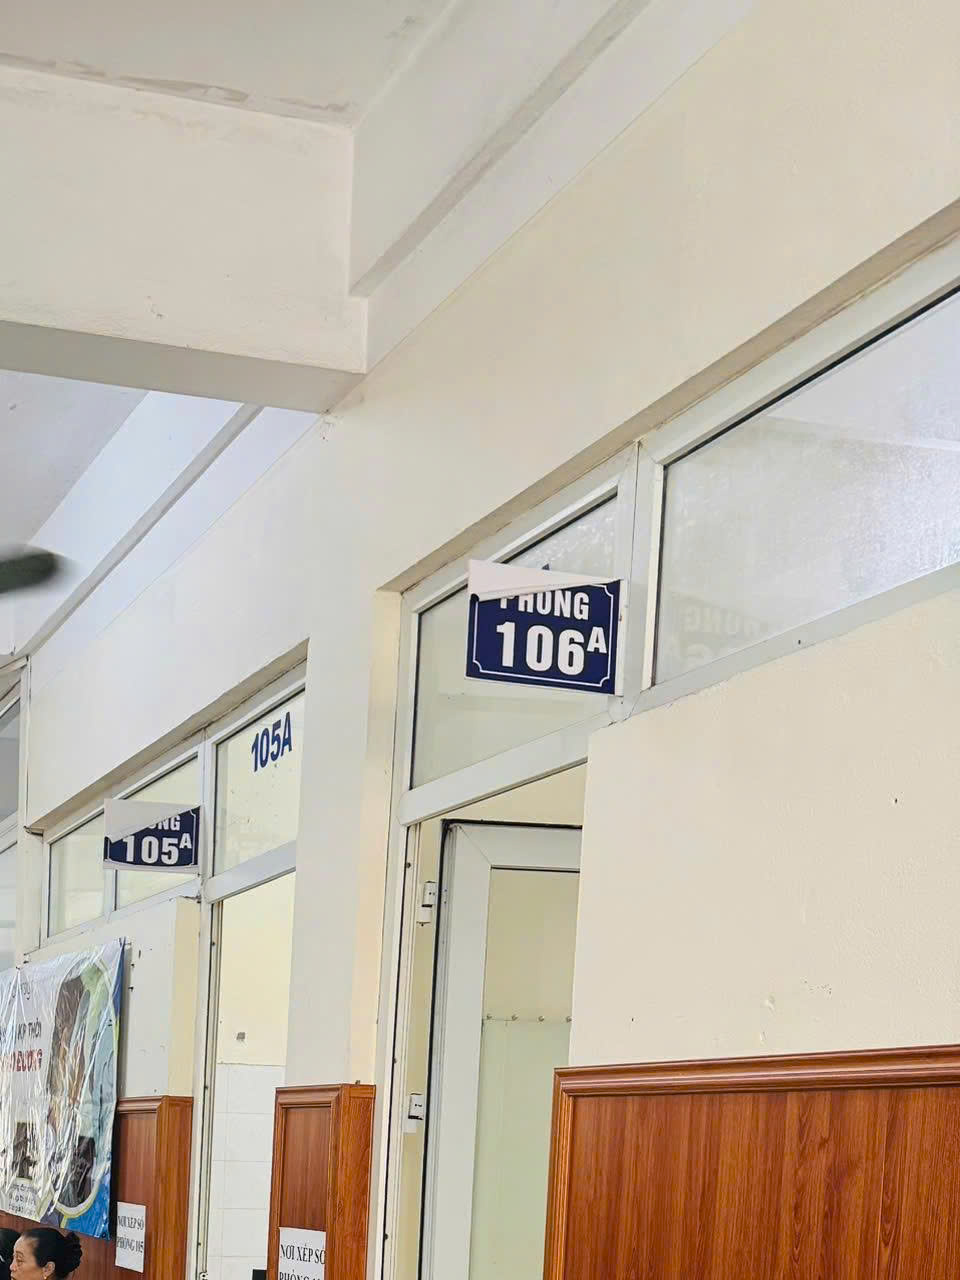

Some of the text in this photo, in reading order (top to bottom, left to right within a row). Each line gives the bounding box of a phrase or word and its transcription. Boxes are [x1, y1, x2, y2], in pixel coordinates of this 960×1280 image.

[496, 621, 608, 676] 106A
[251, 711, 292, 773] 105A
[122, 832, 192, 865] 105A
